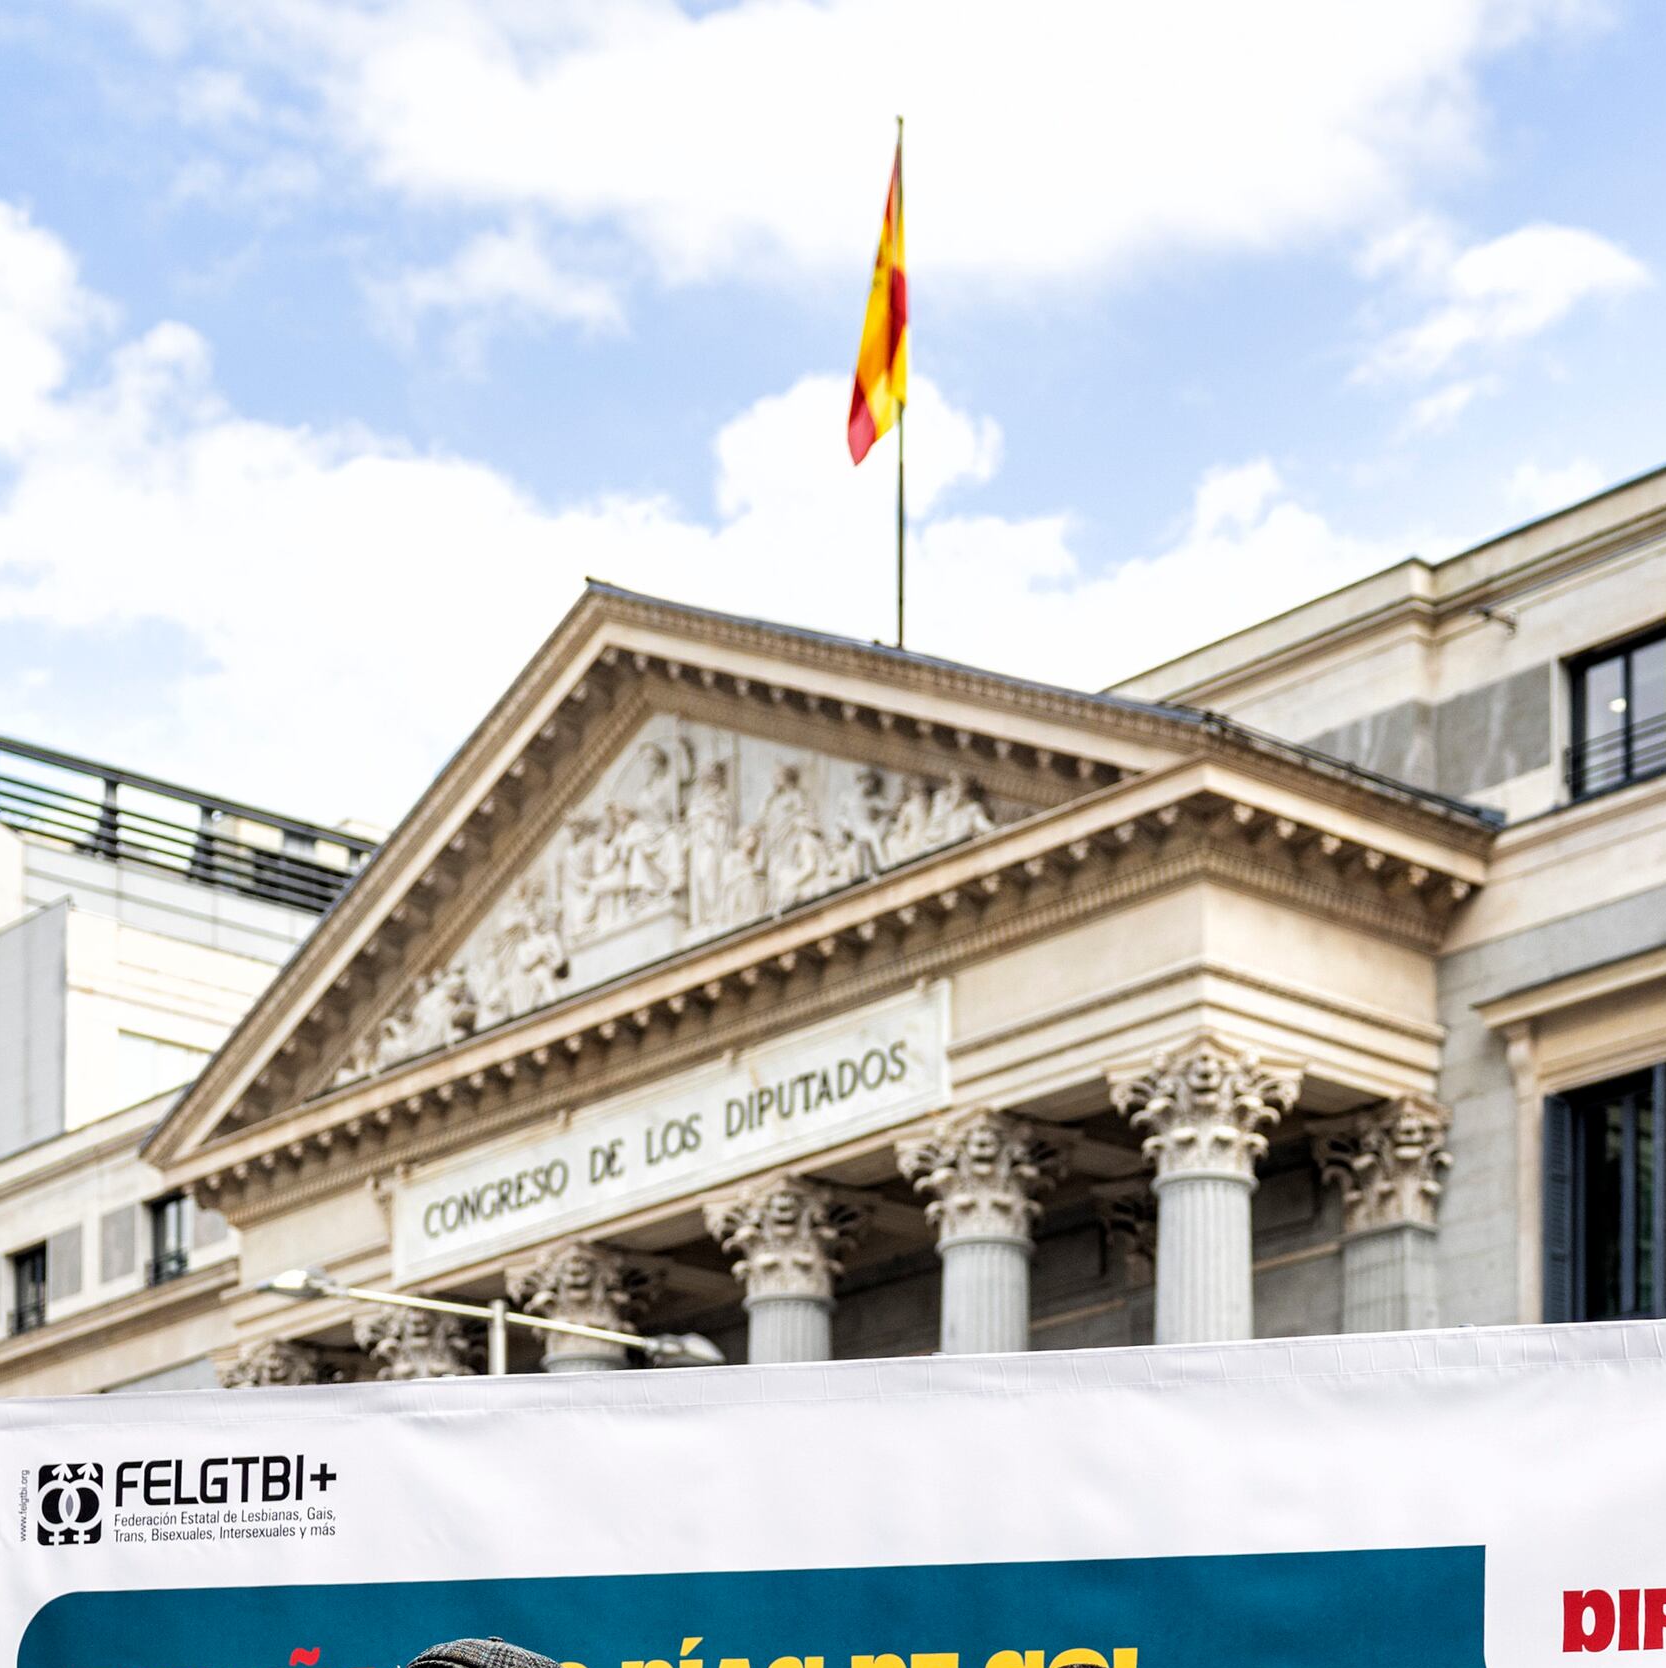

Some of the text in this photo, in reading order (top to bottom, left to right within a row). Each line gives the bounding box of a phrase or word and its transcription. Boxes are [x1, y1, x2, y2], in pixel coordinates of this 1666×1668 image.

[423, 1040, 908, 1239] CONGRESO DE LOS DIPUTADOS
[115, 1454, 337, 1507] FELGTBI+
[114, 1506, 336, 1528] Federación Estatal de Lesbianas, Gais,
[114, 1524, 336, 1544] Trans, Bisexuales, Intersexuales y más
